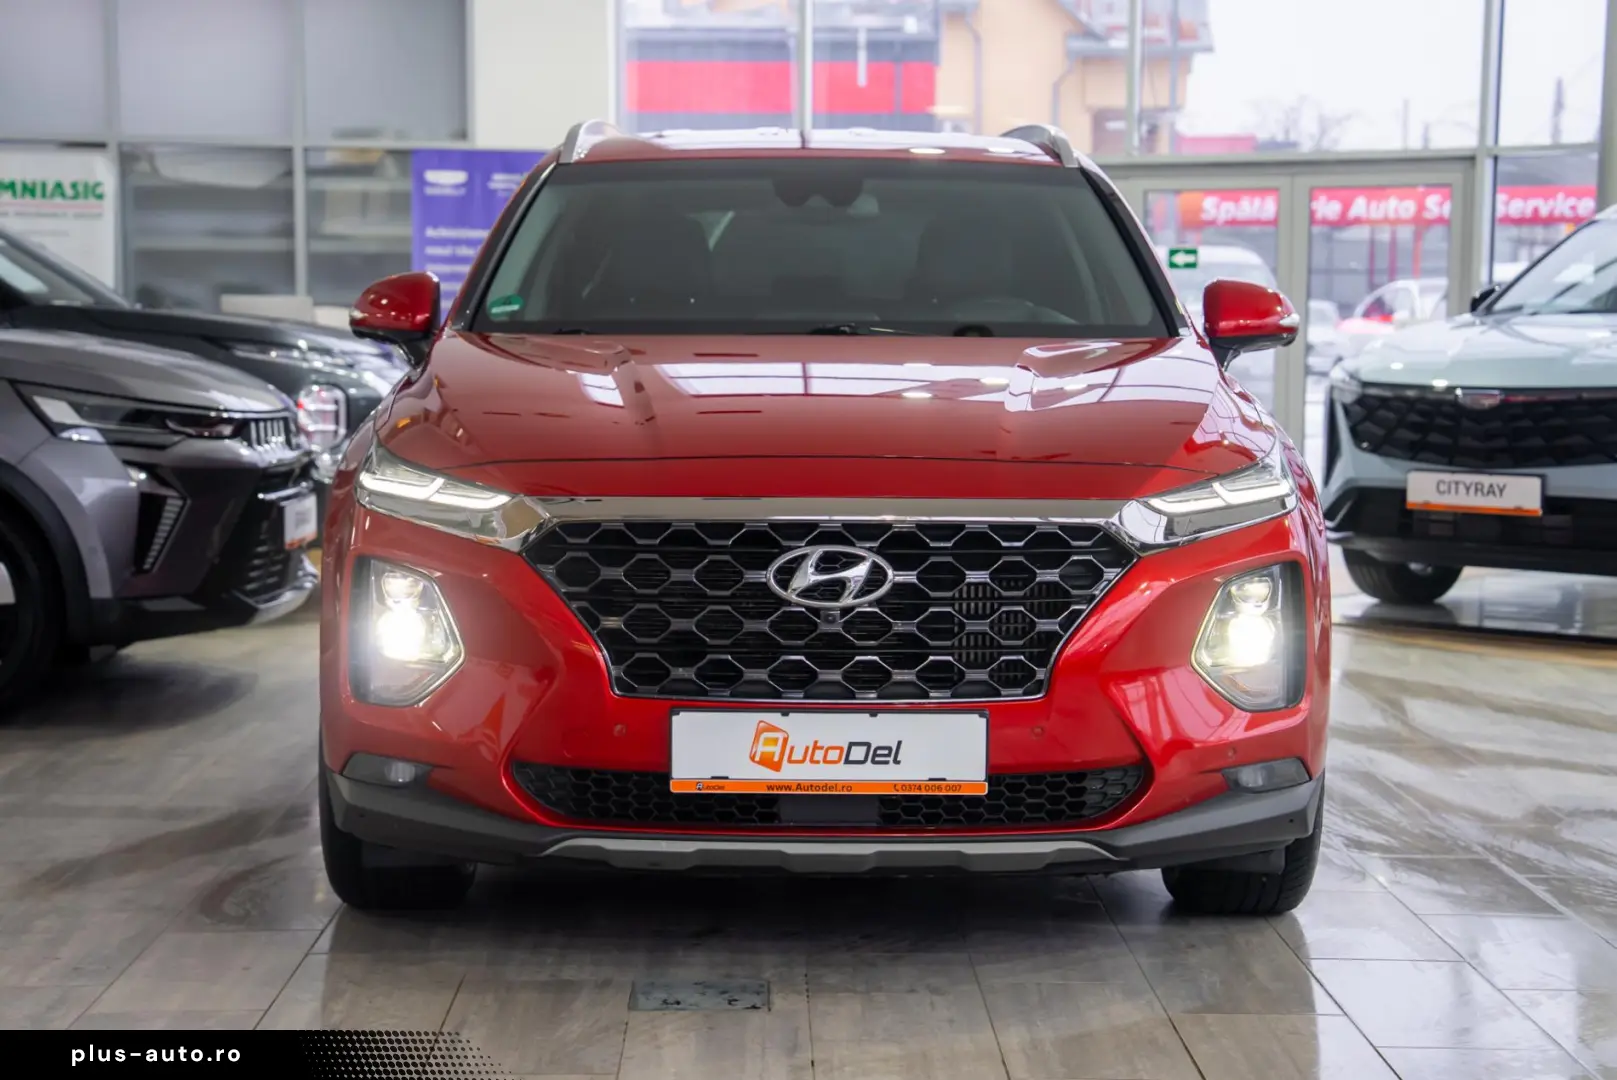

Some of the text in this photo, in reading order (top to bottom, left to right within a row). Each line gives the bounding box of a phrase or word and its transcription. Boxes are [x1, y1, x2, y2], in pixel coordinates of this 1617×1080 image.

[1347, 195, 1416, 220] Auto
[1436, 480, 1507, 497] CITYRAY
[752, 729, 903, 767] AutoDel
[766, 783, 853, 792] www.Autodel.ro
[901, 784, 962, 792] 0374 006 007
